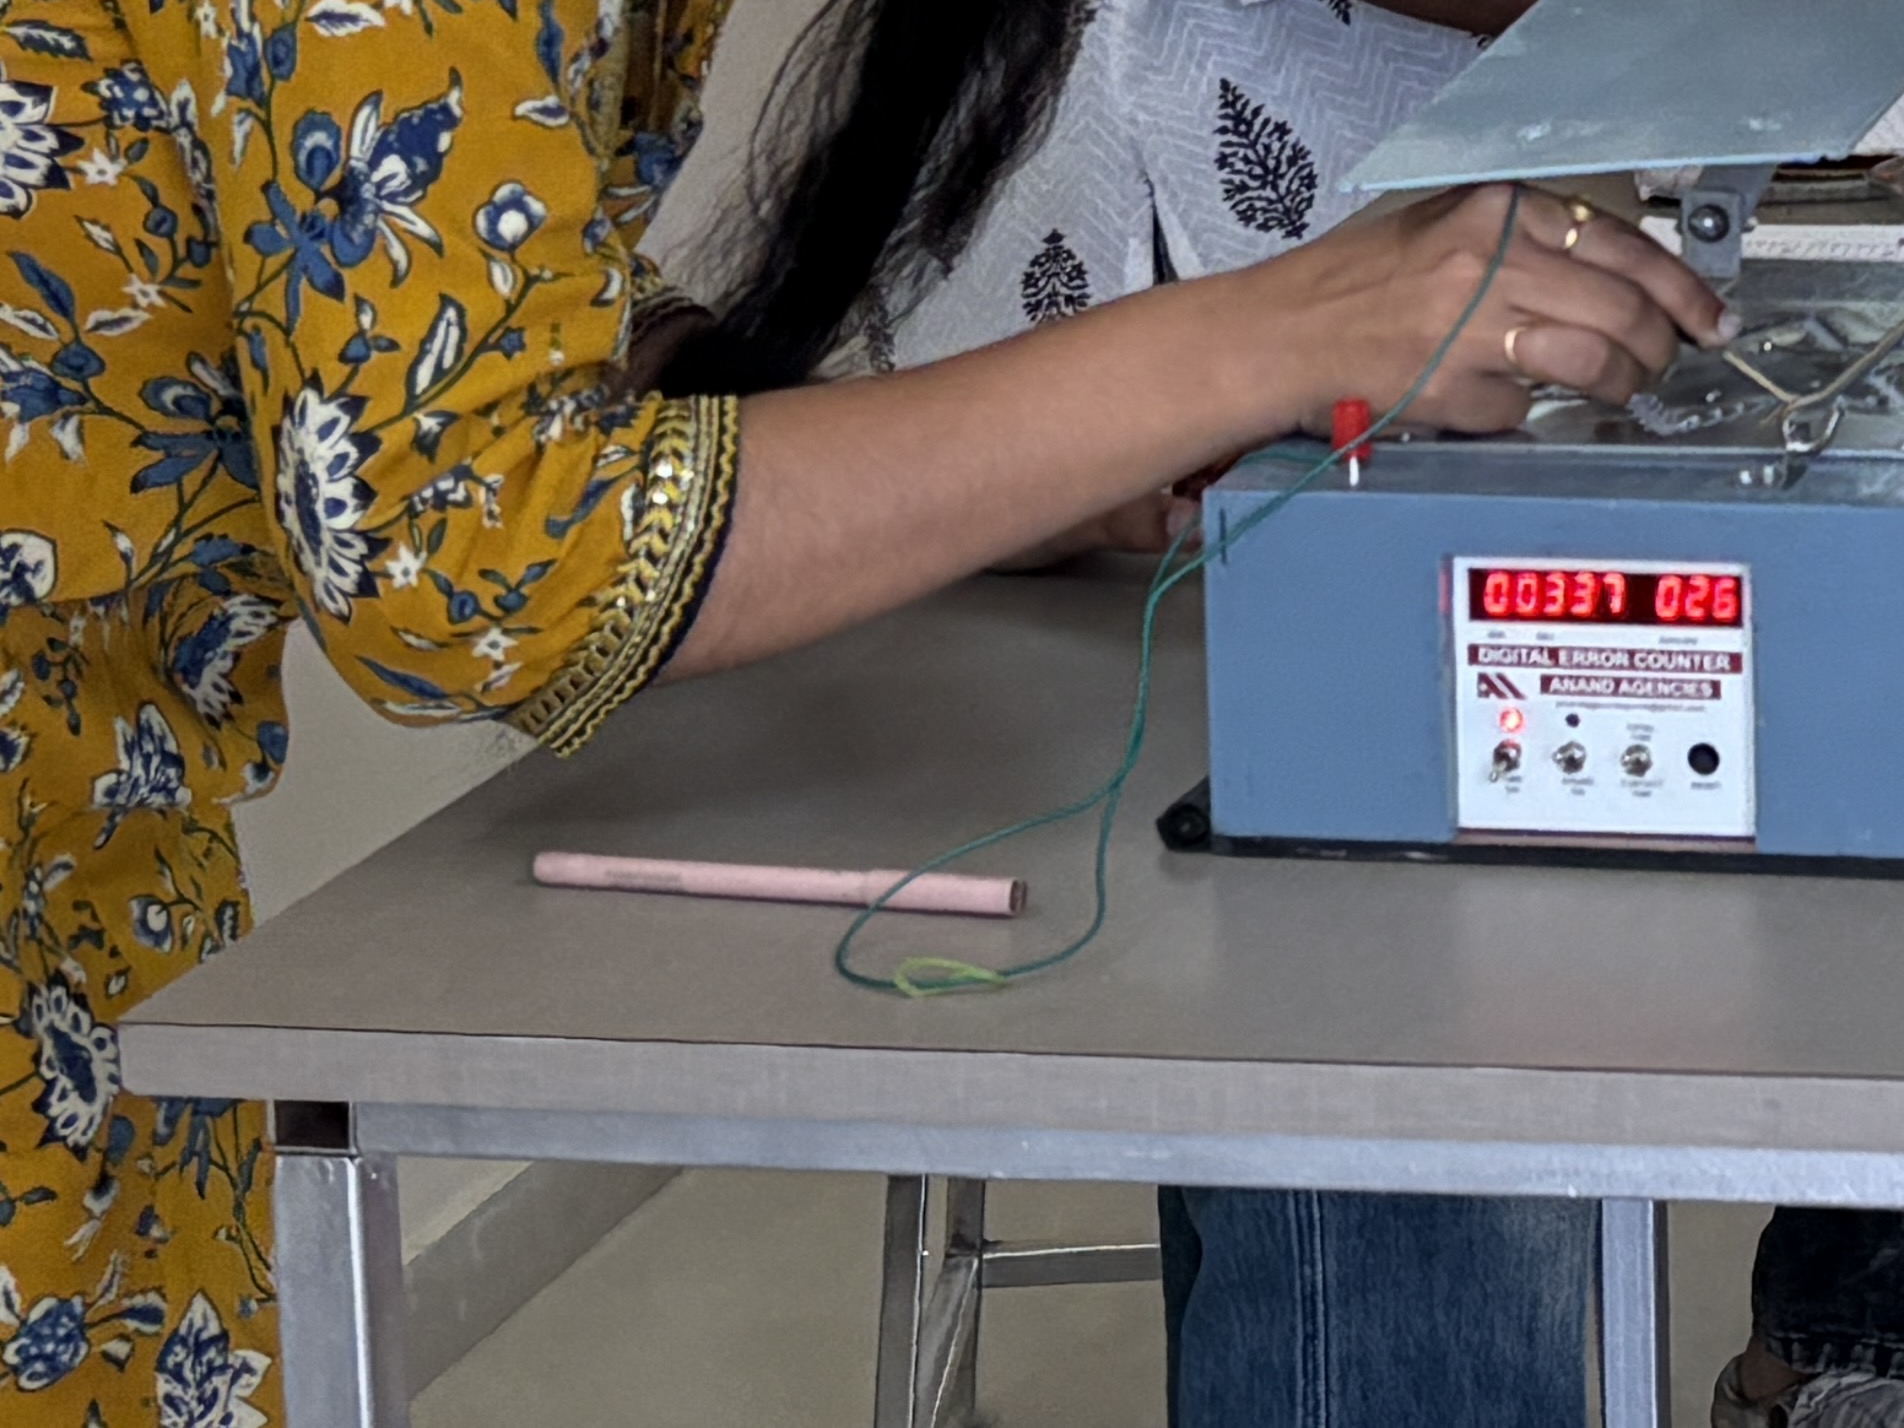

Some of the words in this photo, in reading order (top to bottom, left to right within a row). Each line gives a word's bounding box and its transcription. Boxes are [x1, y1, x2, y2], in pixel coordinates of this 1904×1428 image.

[1483, 572, 1627, 617] 00337
[1656, 575, 1740, 622] 026
[1478, 647, 1553, 666] DIGITAL
[1559, 650, 1630, 668] ERROR
[1634, 651, 1731, 671] COUNTER
[1549, 677, 1613, 696] ANAND
[1618, 679, 1713, 698] AGENCIES
